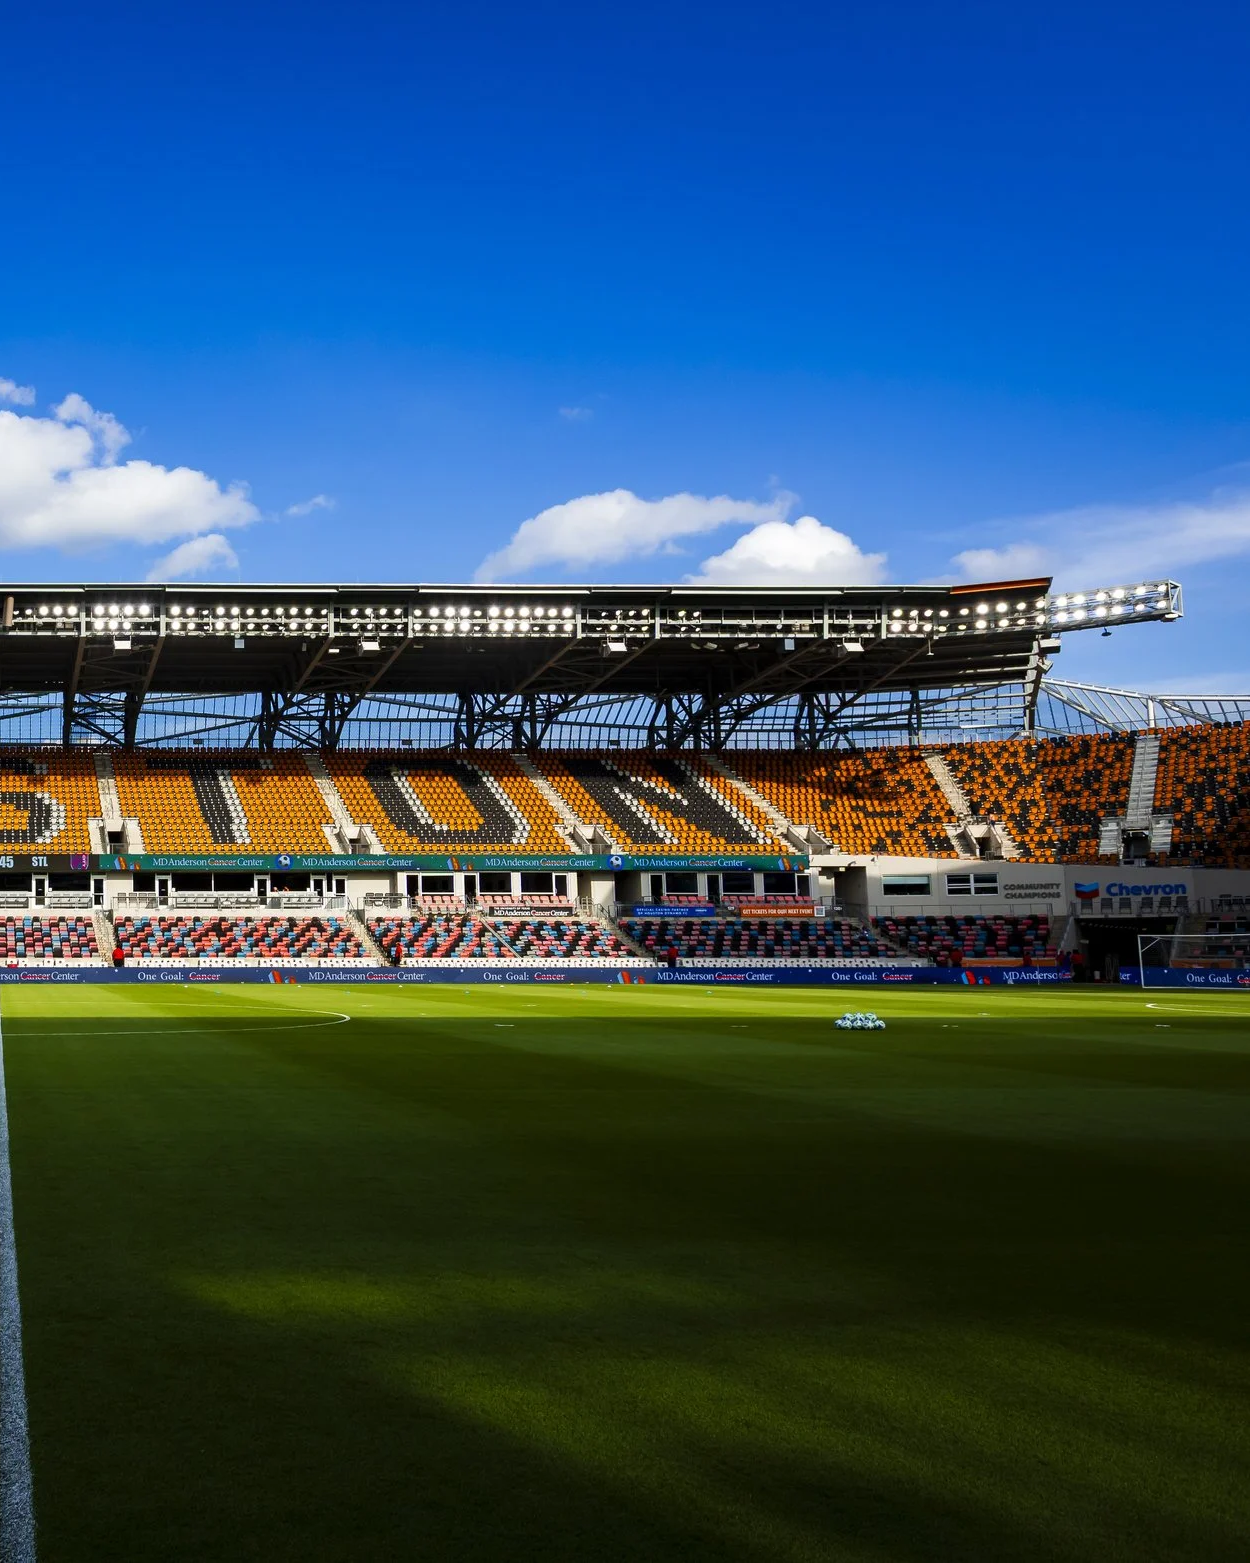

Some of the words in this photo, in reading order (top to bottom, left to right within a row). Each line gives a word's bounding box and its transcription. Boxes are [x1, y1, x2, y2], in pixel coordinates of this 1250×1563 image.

[32, 856, 48, 867] STL
[208, 857, 237, 866] Cancer
[237, 857, 263, 866] Center
[357, 858, 386, 866] Cancer
[386, 858, 412, 866] Center
[540, 858, 568, 867] Cancer
[569, 858, 595, 867] Center
[688, 858, 717, 867] Cancer
[717, 858, 743, 867] Center
[1003, 883, 1061, 891] COMMUNITY
[1106, 882, 1187, 897] Chevron
[1004, 891, 1061, 900] CHAMPIONS
[20, 971, 51, 981] Cancer
[51, 971, 78, 981] Center
[138, 971, 156, 981] One
[161, 971, 184, 981] Goal:
[190, 971, 221, 981] Cancer
[366, 971, 397, 981] Cancer
[397, 971, 424, 981] Center
[483, 971, 502, 981] One
[506, 971, 529, 981] Goal:
[534, 971, 565, 981] Cancer
[715, 971, 746, 981] Cancer
[746, 971, 773, 981] Center
[832, 971, 850, 981] One
[854, 971, 877, 981] Goal:
[882, 971, 913, 981] Cancer
[1186, 973, 1205, 983] One
[1208, 973, 1232, 983] Goal:
